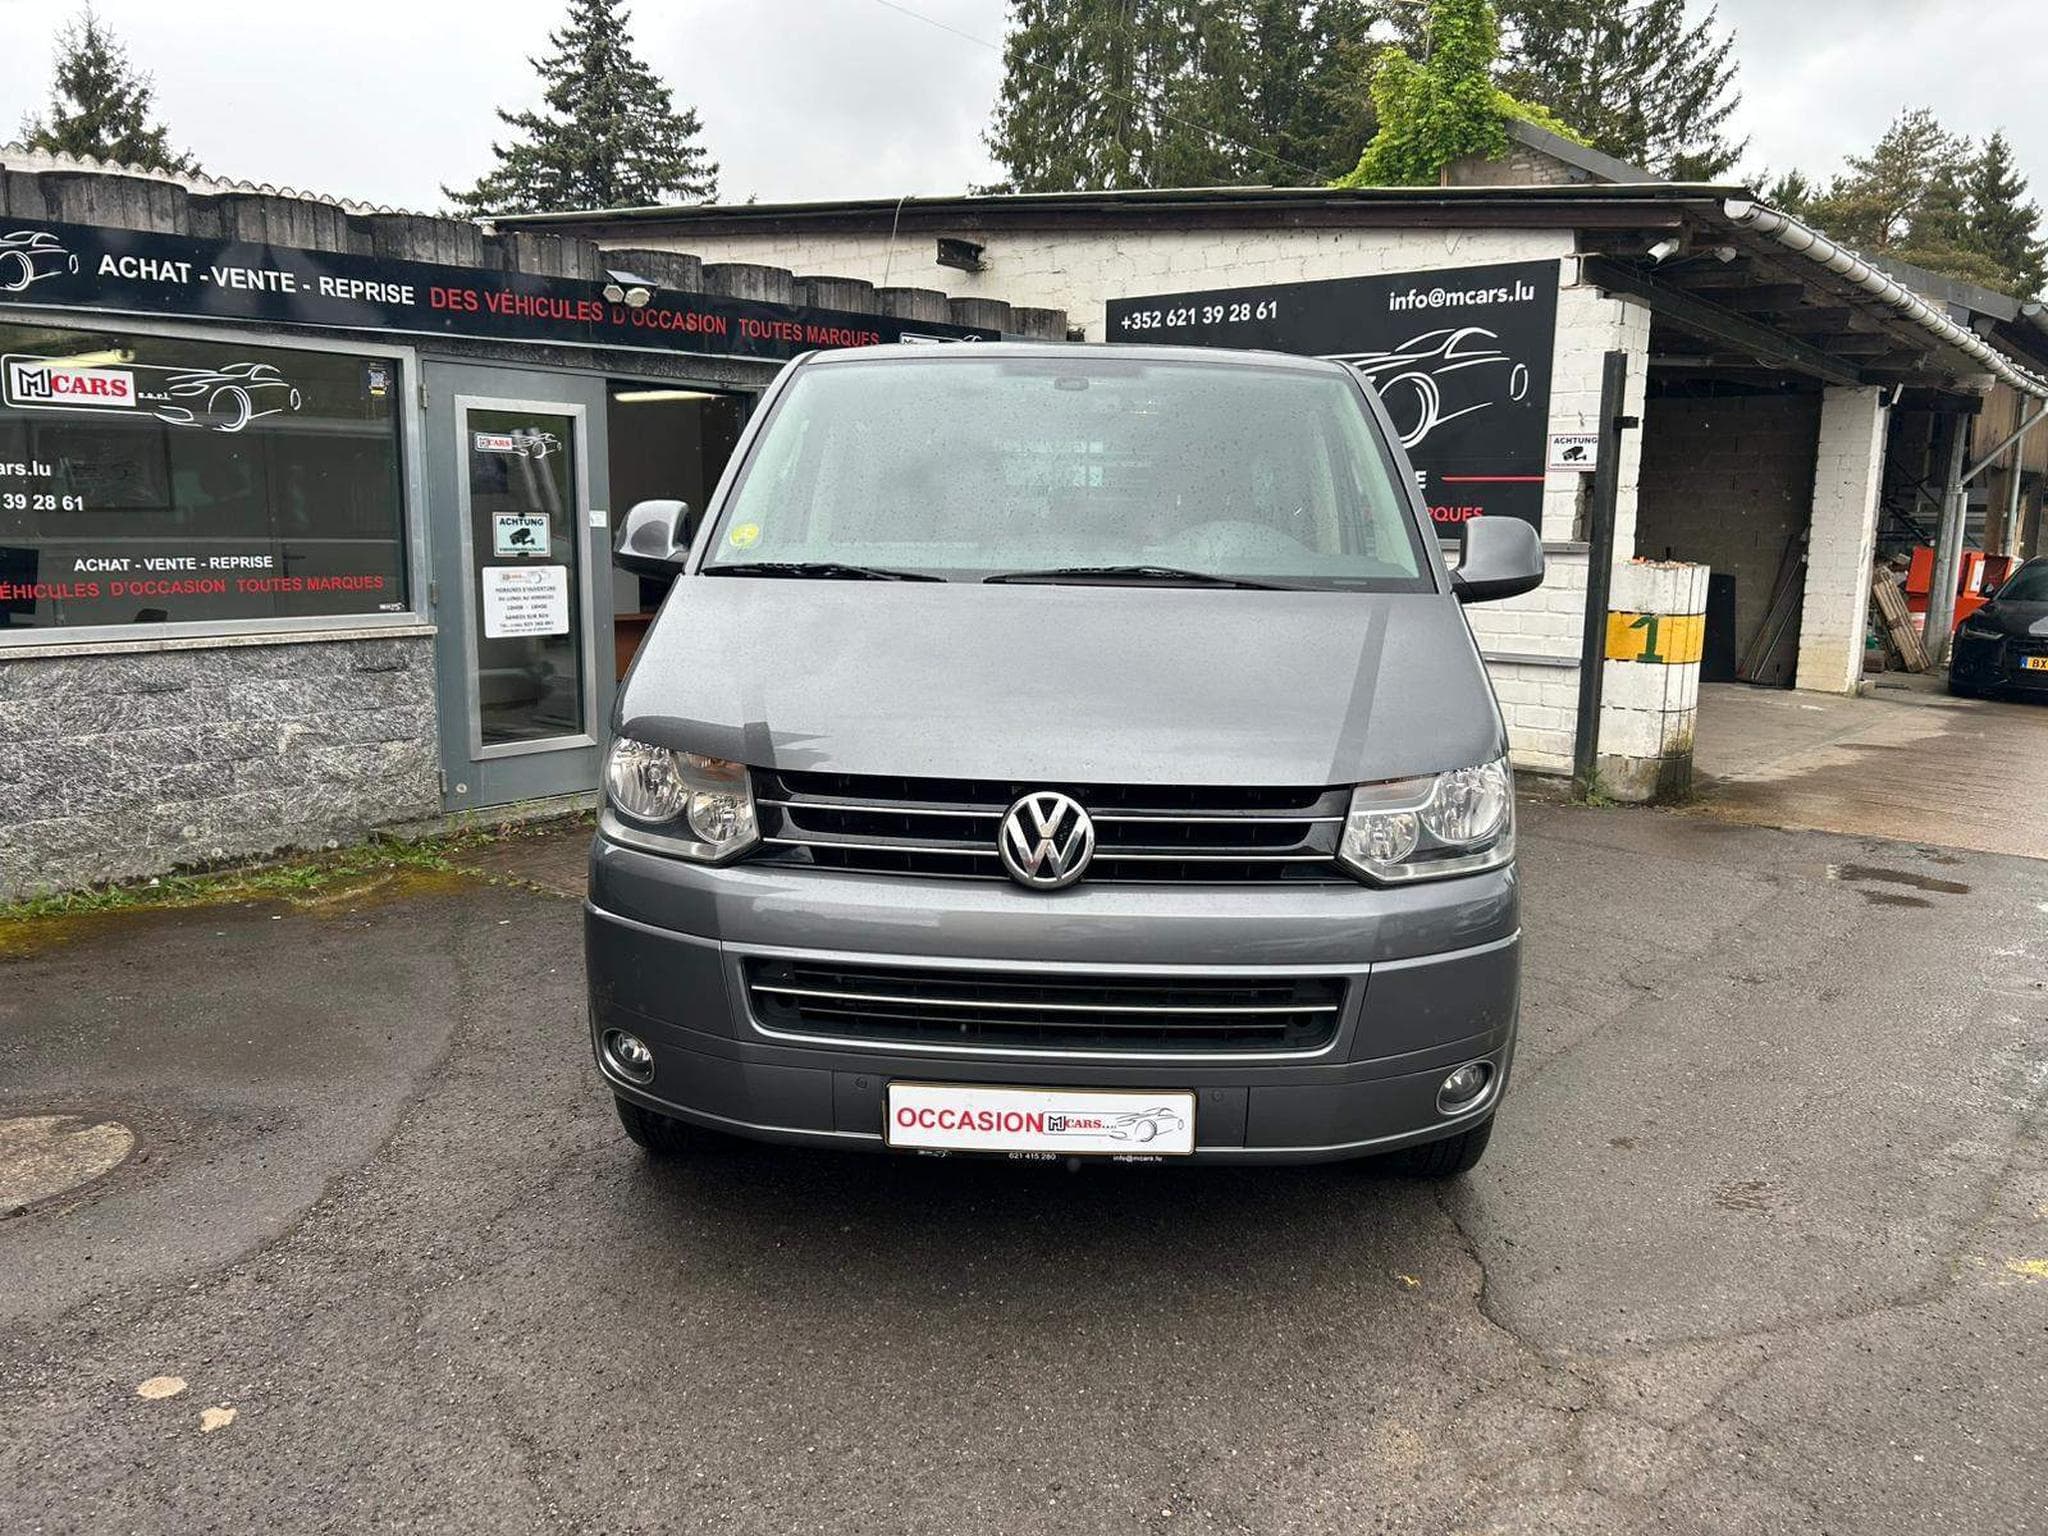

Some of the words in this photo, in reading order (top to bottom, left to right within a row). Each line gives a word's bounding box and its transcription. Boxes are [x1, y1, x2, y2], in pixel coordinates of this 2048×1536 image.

[98, 254, 192, 284] ACHAT
[319, 276, 415, 305] REPRISE
[430, 287, 478, 311] DES
[485, 288, 603, 321] VÉHICULES
[612, 306, 727, 335] D'OCCASION
[739, 318, 802, 341] TOUTES
[806, 325, 880, 346] MARQUES
[1389, 280, 1534, 311] info@mcars.lu
[1121, 311, 1161, 330] +352
[1166, 307, 1196, 326] 621
[1202, 305, 1224, 324] 39
[1229, 303, 1251, 321] 28
[1256, 300, 1277, 320] 61
[1554, 436, 1598, 445] ACHTUNG
[3, 493, 27, 510] 39
[32, 494, 57, 511] 28
[62, 495, 84, 511] 61
[499, 518, 544, 526] ACHTUNG
[74, 559, 130, 572] ACHAT
[144, 558, 197, 571] VENTE
[210, 556, 273, 569] REPRISE
[110, 580, 226, 596] D'OCCASION
[237, 578, 303, 593] TOUTES
[307, 576, 384, 591] MARQUES
[1629, 615, 1663, 662] 1
[897, 1107, 1044, 1132] OCCASION
